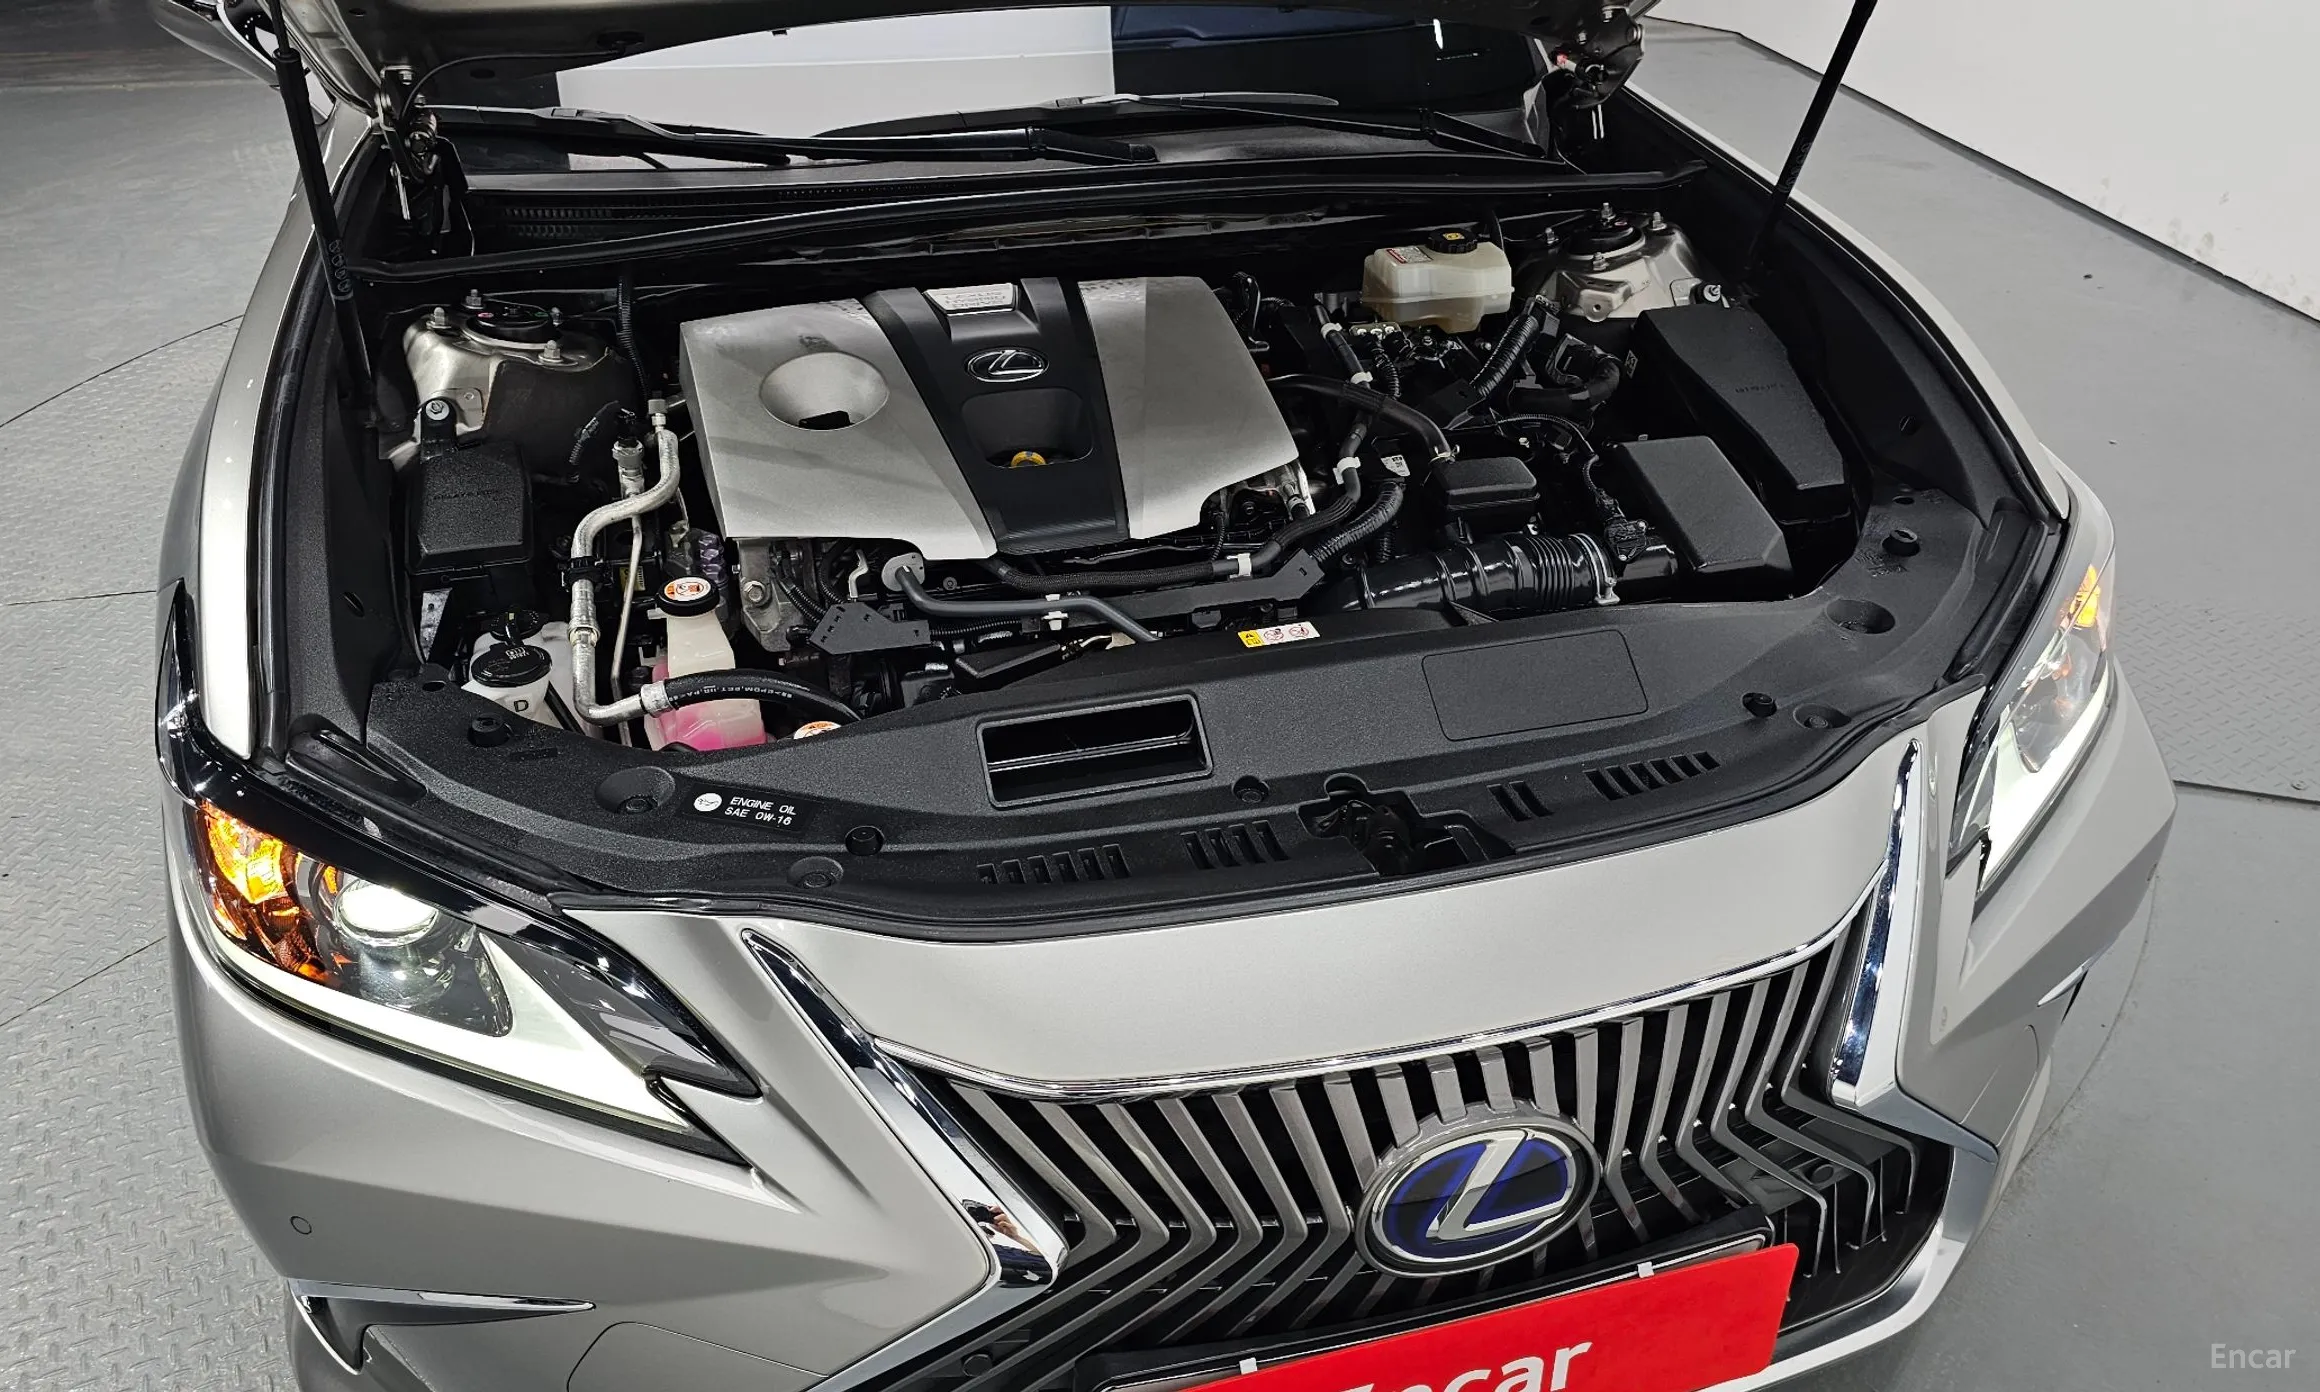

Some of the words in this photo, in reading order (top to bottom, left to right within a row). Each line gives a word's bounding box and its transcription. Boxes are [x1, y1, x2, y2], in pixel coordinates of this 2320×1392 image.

[724, 806, 751, 818] SAE
[729, 796, 774, 811] ENGINE
[778, 804, 797, 816] OIL
